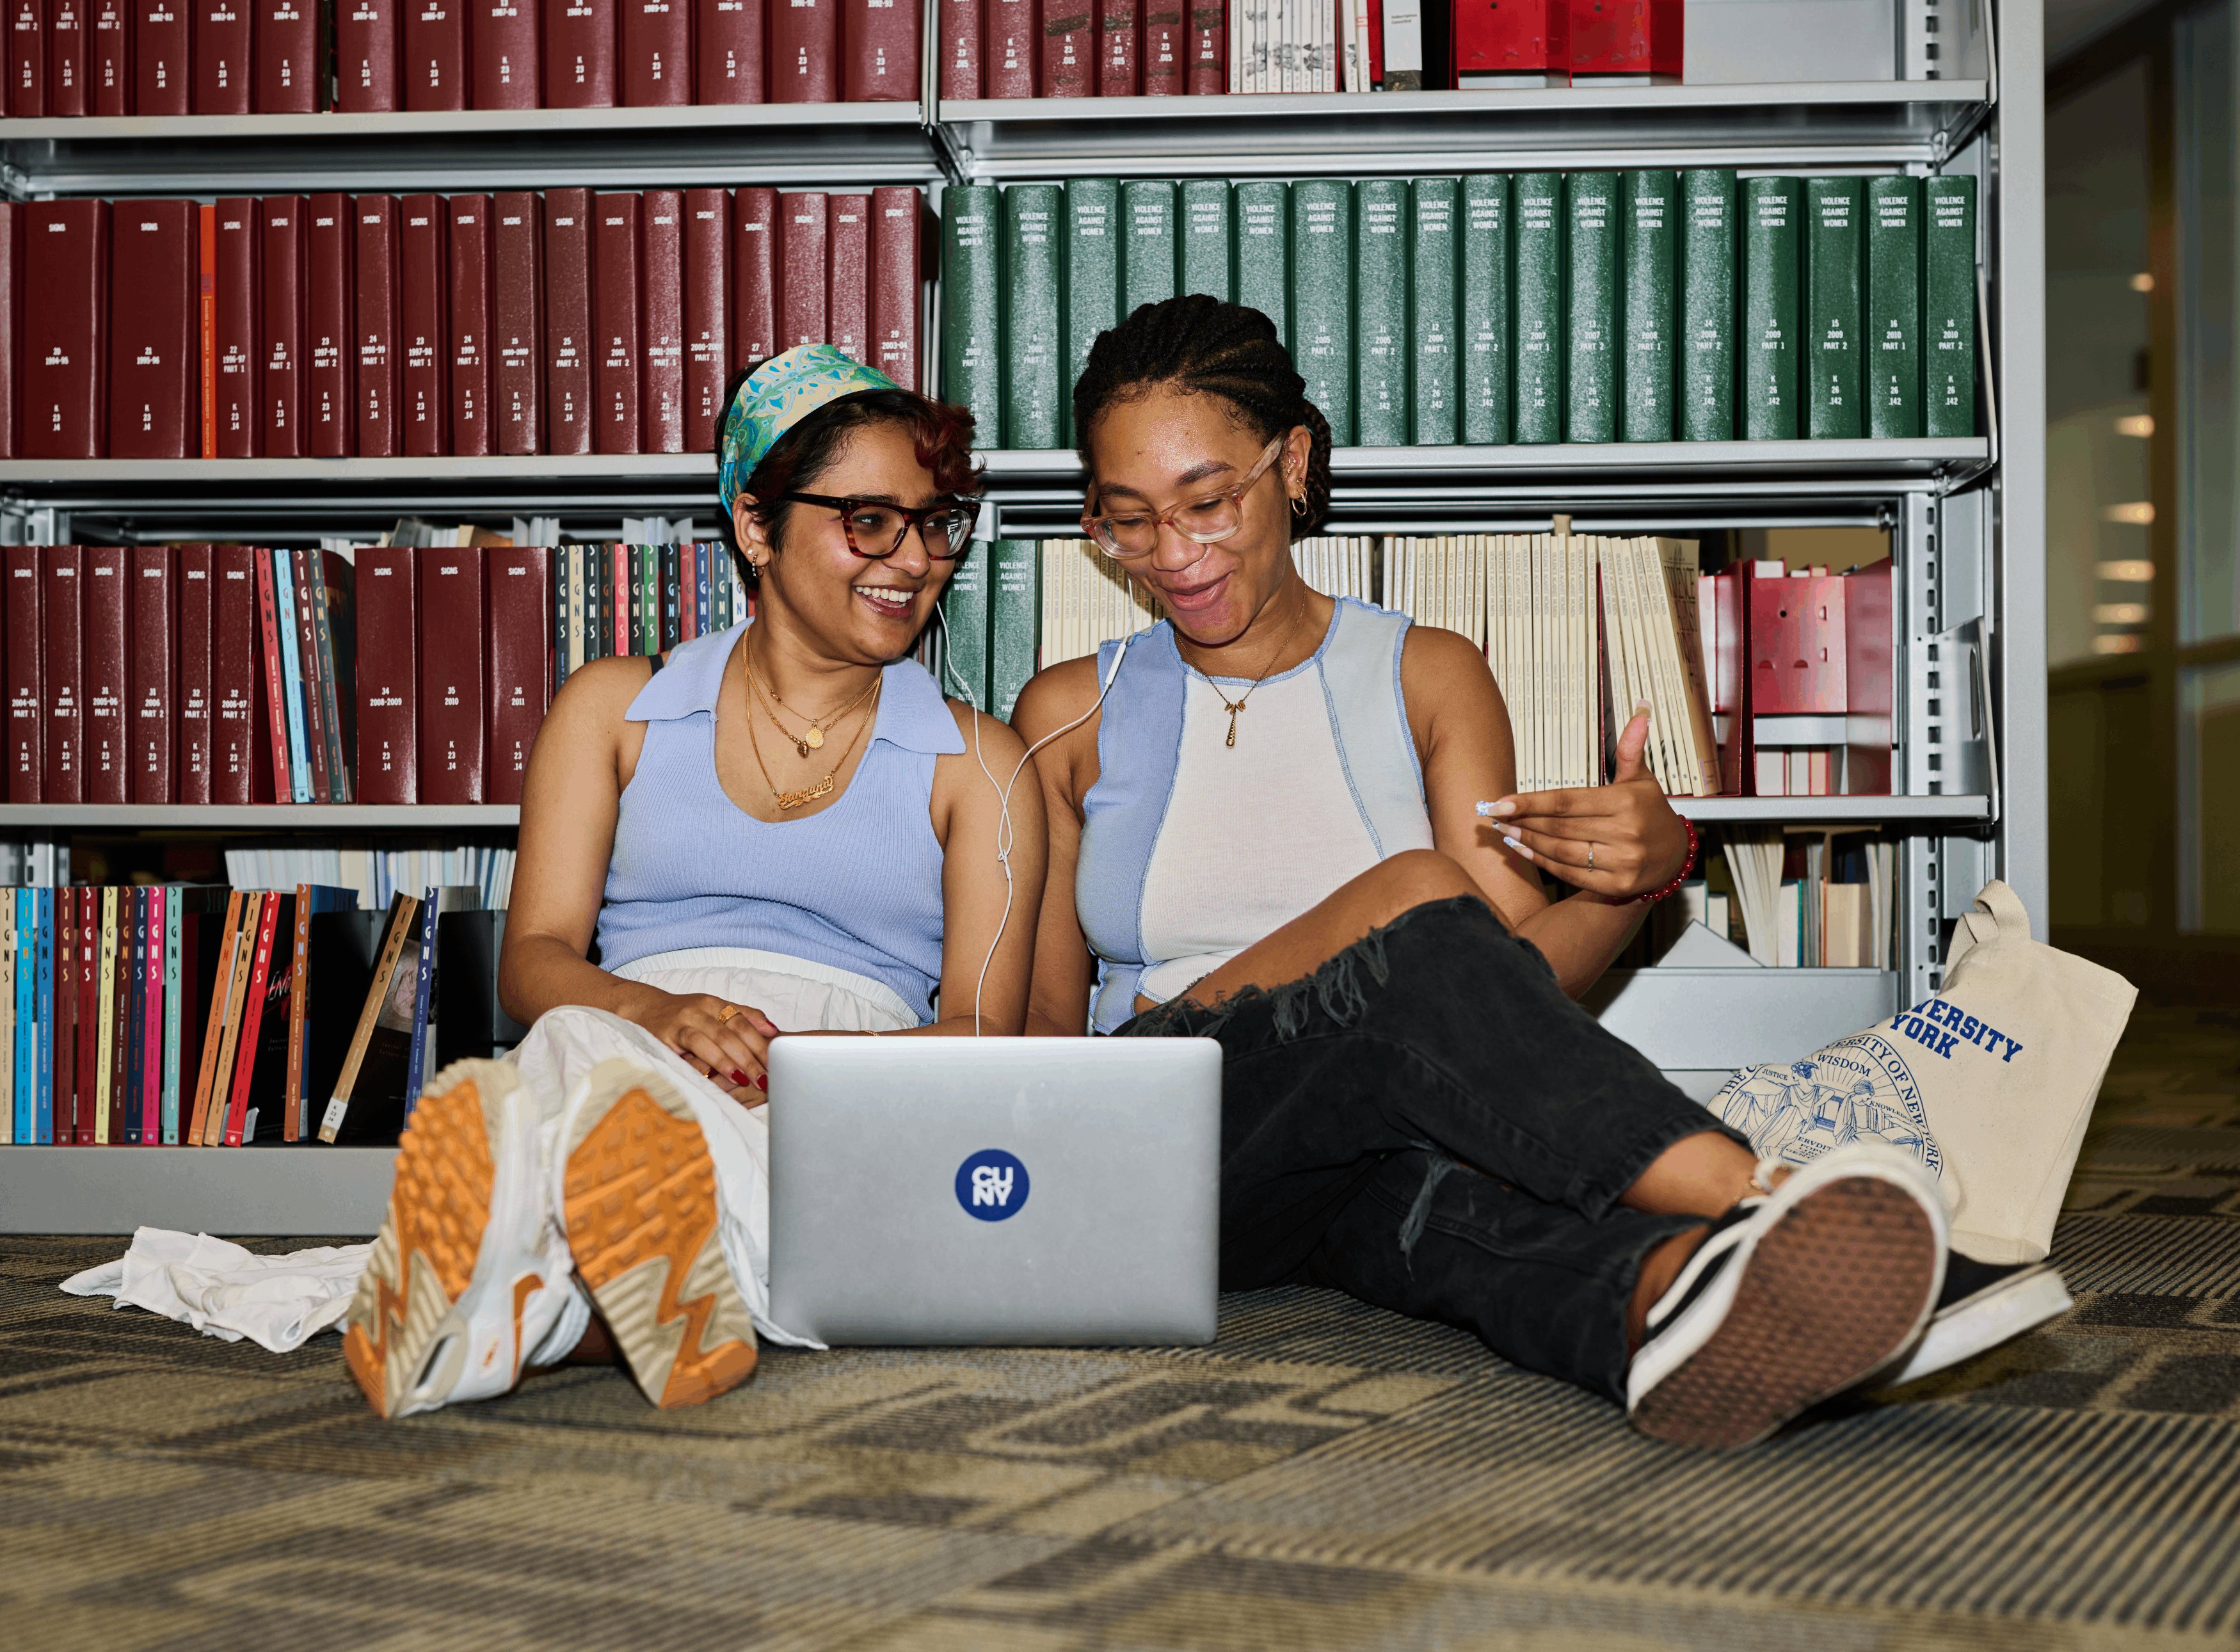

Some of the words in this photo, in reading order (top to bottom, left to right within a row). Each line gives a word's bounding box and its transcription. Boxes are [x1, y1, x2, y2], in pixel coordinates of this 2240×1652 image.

[1635, 197, 1664, 205] VIOLENCE
[1878, 196, 1908, 205] VIOLENCE
[1422, 211, 1449, 220] AGAINST
[1759, 207, 1786, 215] AGAINST
[1880, 207, 1907, 216] AGAINST
[1937, 207, 1963, 215] AGAINST
[317, 218, 333, 227] SIGNS
[1308, 214, 1334, 222] AGAINST
[1939, 218, 1962, 227] WOMEN
[1526, 220, 1550, 229] WOMEN
[1638, 220, 1662, 228] WOMEN
[1310, 225, 1334, 233] WOMEN
[1948, 319, 1955, 327] 16
[315, 348, 337, 357] 1997-98
[315, 359, 329, 367] PART
[1948, 386, 1955, 394] 26
[15, 569, 32, 577] SIGNS
[57, 568, 74, 577] SIGNS
[95, 567, 113, 576] SIGNS
[143, 568, 161, 577] SIGNS
[188, 570, 205, 579] SIGNS
[227, 571, 244, 579] SIGNS
[374, 568, 392, 576] SIGNS
[441, 566, 458, 575] SIGNS
[508, 567, 525, 575] SIGNS
[260, 549, 273, 643] SIGNS
[280, 550, 292, 640] SIGNS
[298, 550, 311, 641] SIGNS
[312, 550, 326, 641] SIGNS
[231, 689, 238, 698] 32
[382, 687, 389, 695] 34
[370, 698, 402, 706] 2008-2009
[230, 753, 237, 762] 23
[122, 886, 130, 979] SIGNS
[137, 887, 145, 980] SIGNS
[298, 884, 306, 976] SIGNS
[422, 887, 434, 980] SIGNS
[221, 892, 237, 982] SIGNS
[239, 892, 257, 982] SIGNS
[256, 891, 275, 983] SIGNS
[380, 897, 412, 983] SIGNS
[268, 971, 291, 1000] ENO
[1890, 1014, 1960, 1059] YORK
[1818, 1055, 1871, 1077] WISDOM
[1762, 1069, 1788, 1080] JUSTICE
[1718, 1073, 1746, 1095] THE
[1888, 1061, 1908, 1083] OF
[1901, 1086, 1926, 1129] NEW
[1922, 1130, 1939, 1172] YORK
[972, 1166, 1014, 1185] CU
[973, 1185, 1012, 1206] NY
